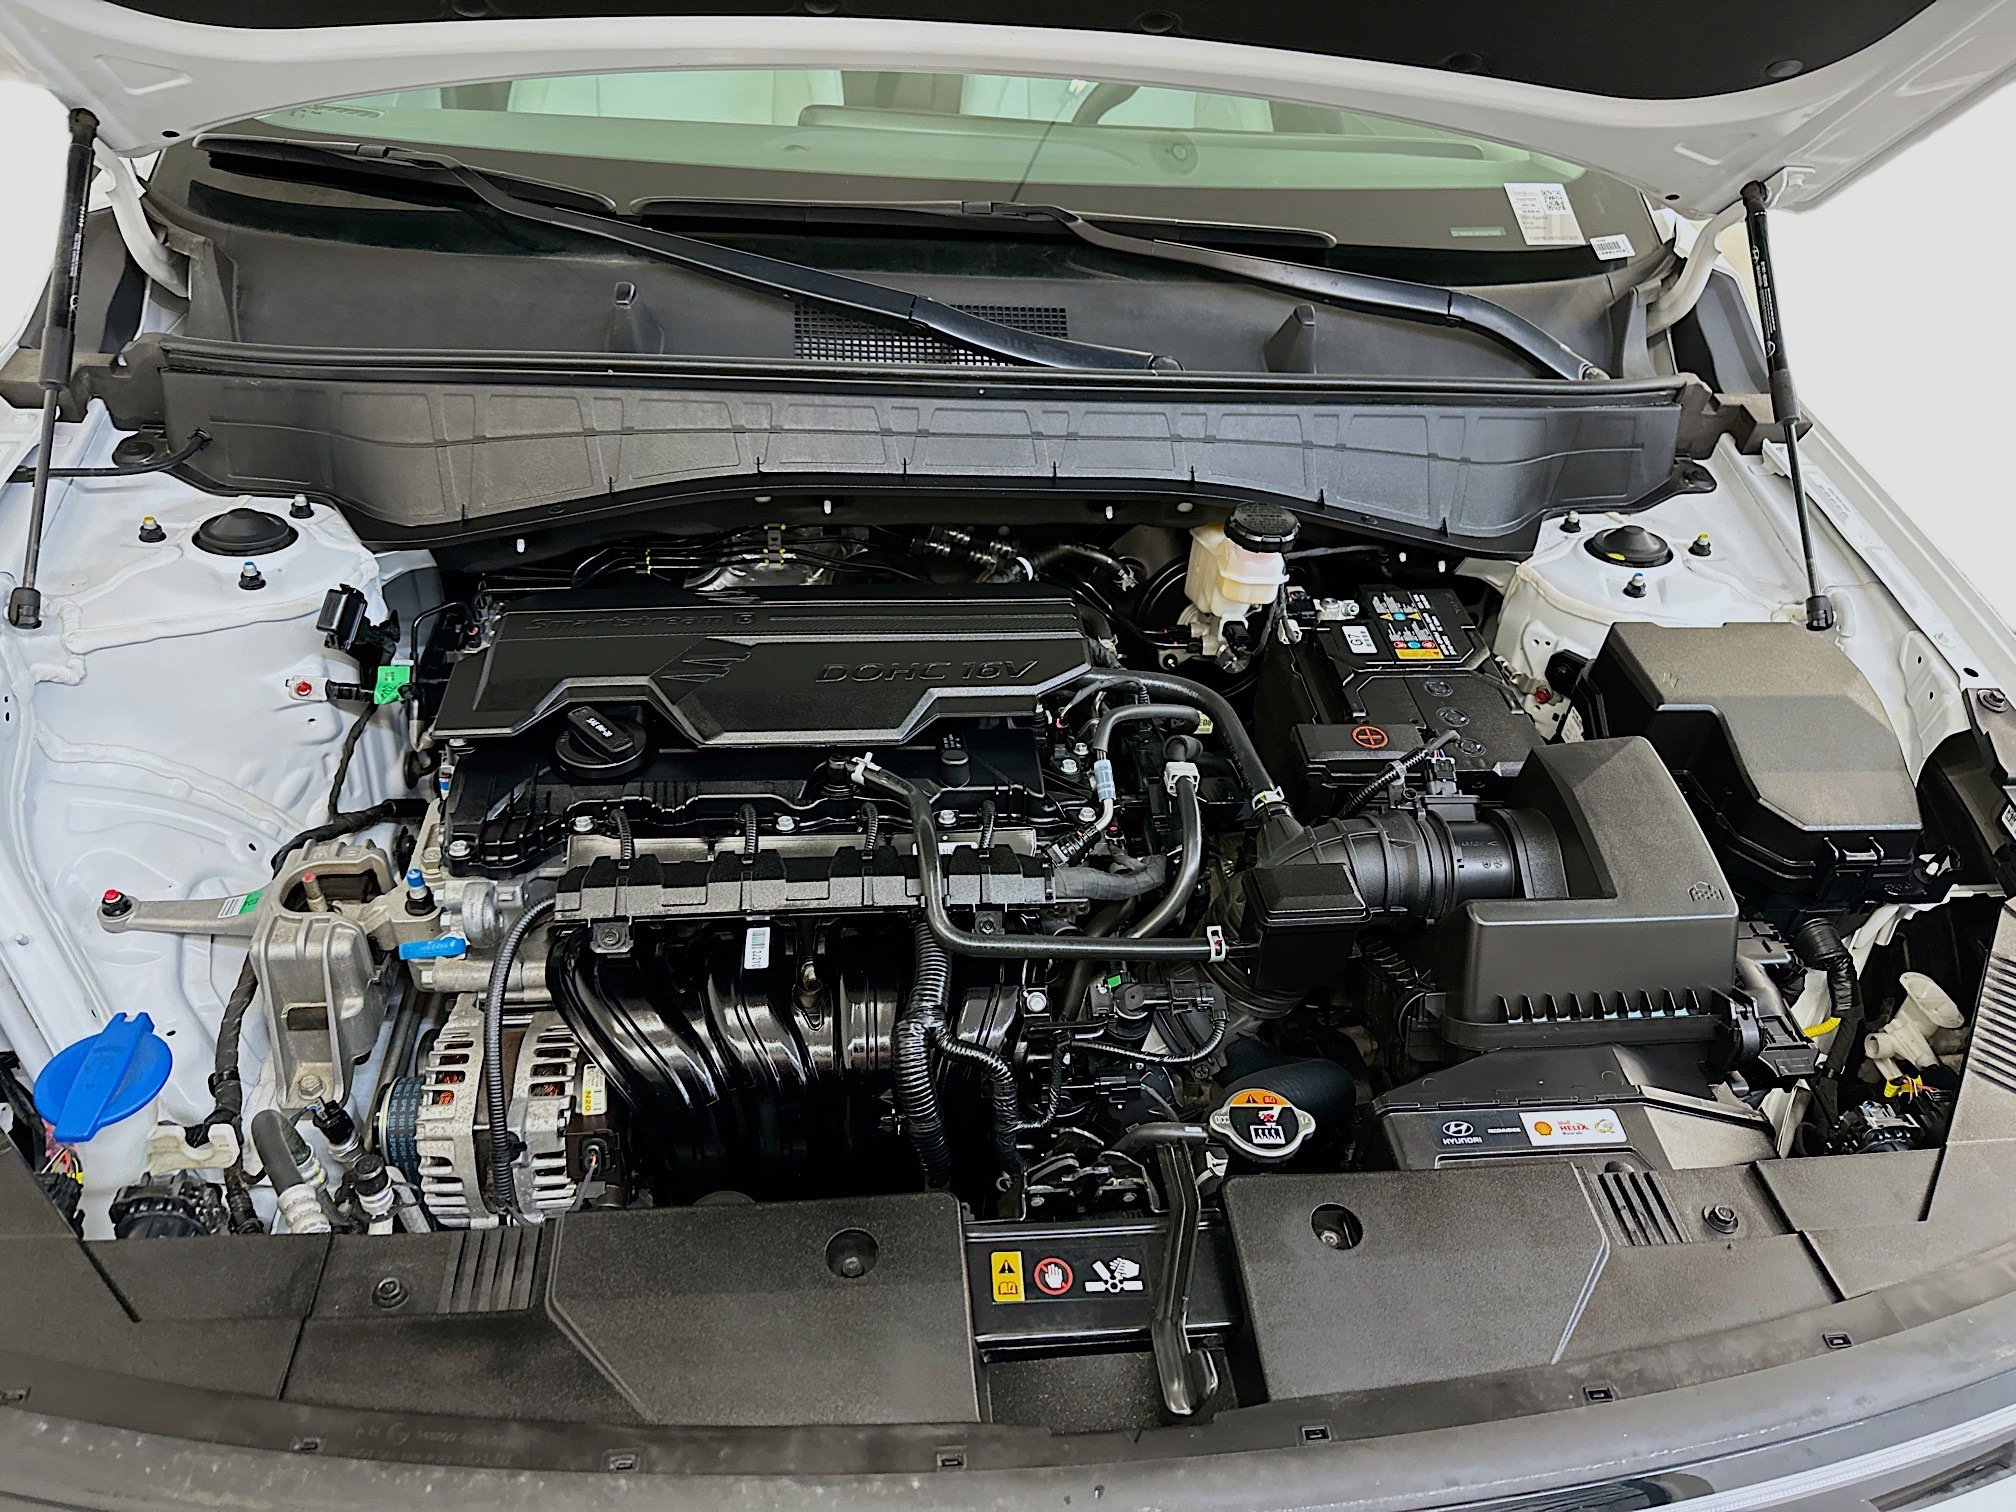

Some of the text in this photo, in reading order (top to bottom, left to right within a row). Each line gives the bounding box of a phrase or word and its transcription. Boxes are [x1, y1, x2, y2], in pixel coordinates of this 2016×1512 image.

[815, 659, 1038, 683] DOHC 16V
[1559, 1122, 1590, 1131] HELIX
[1442, 1136, 1483, 1145] HYUNDAI
